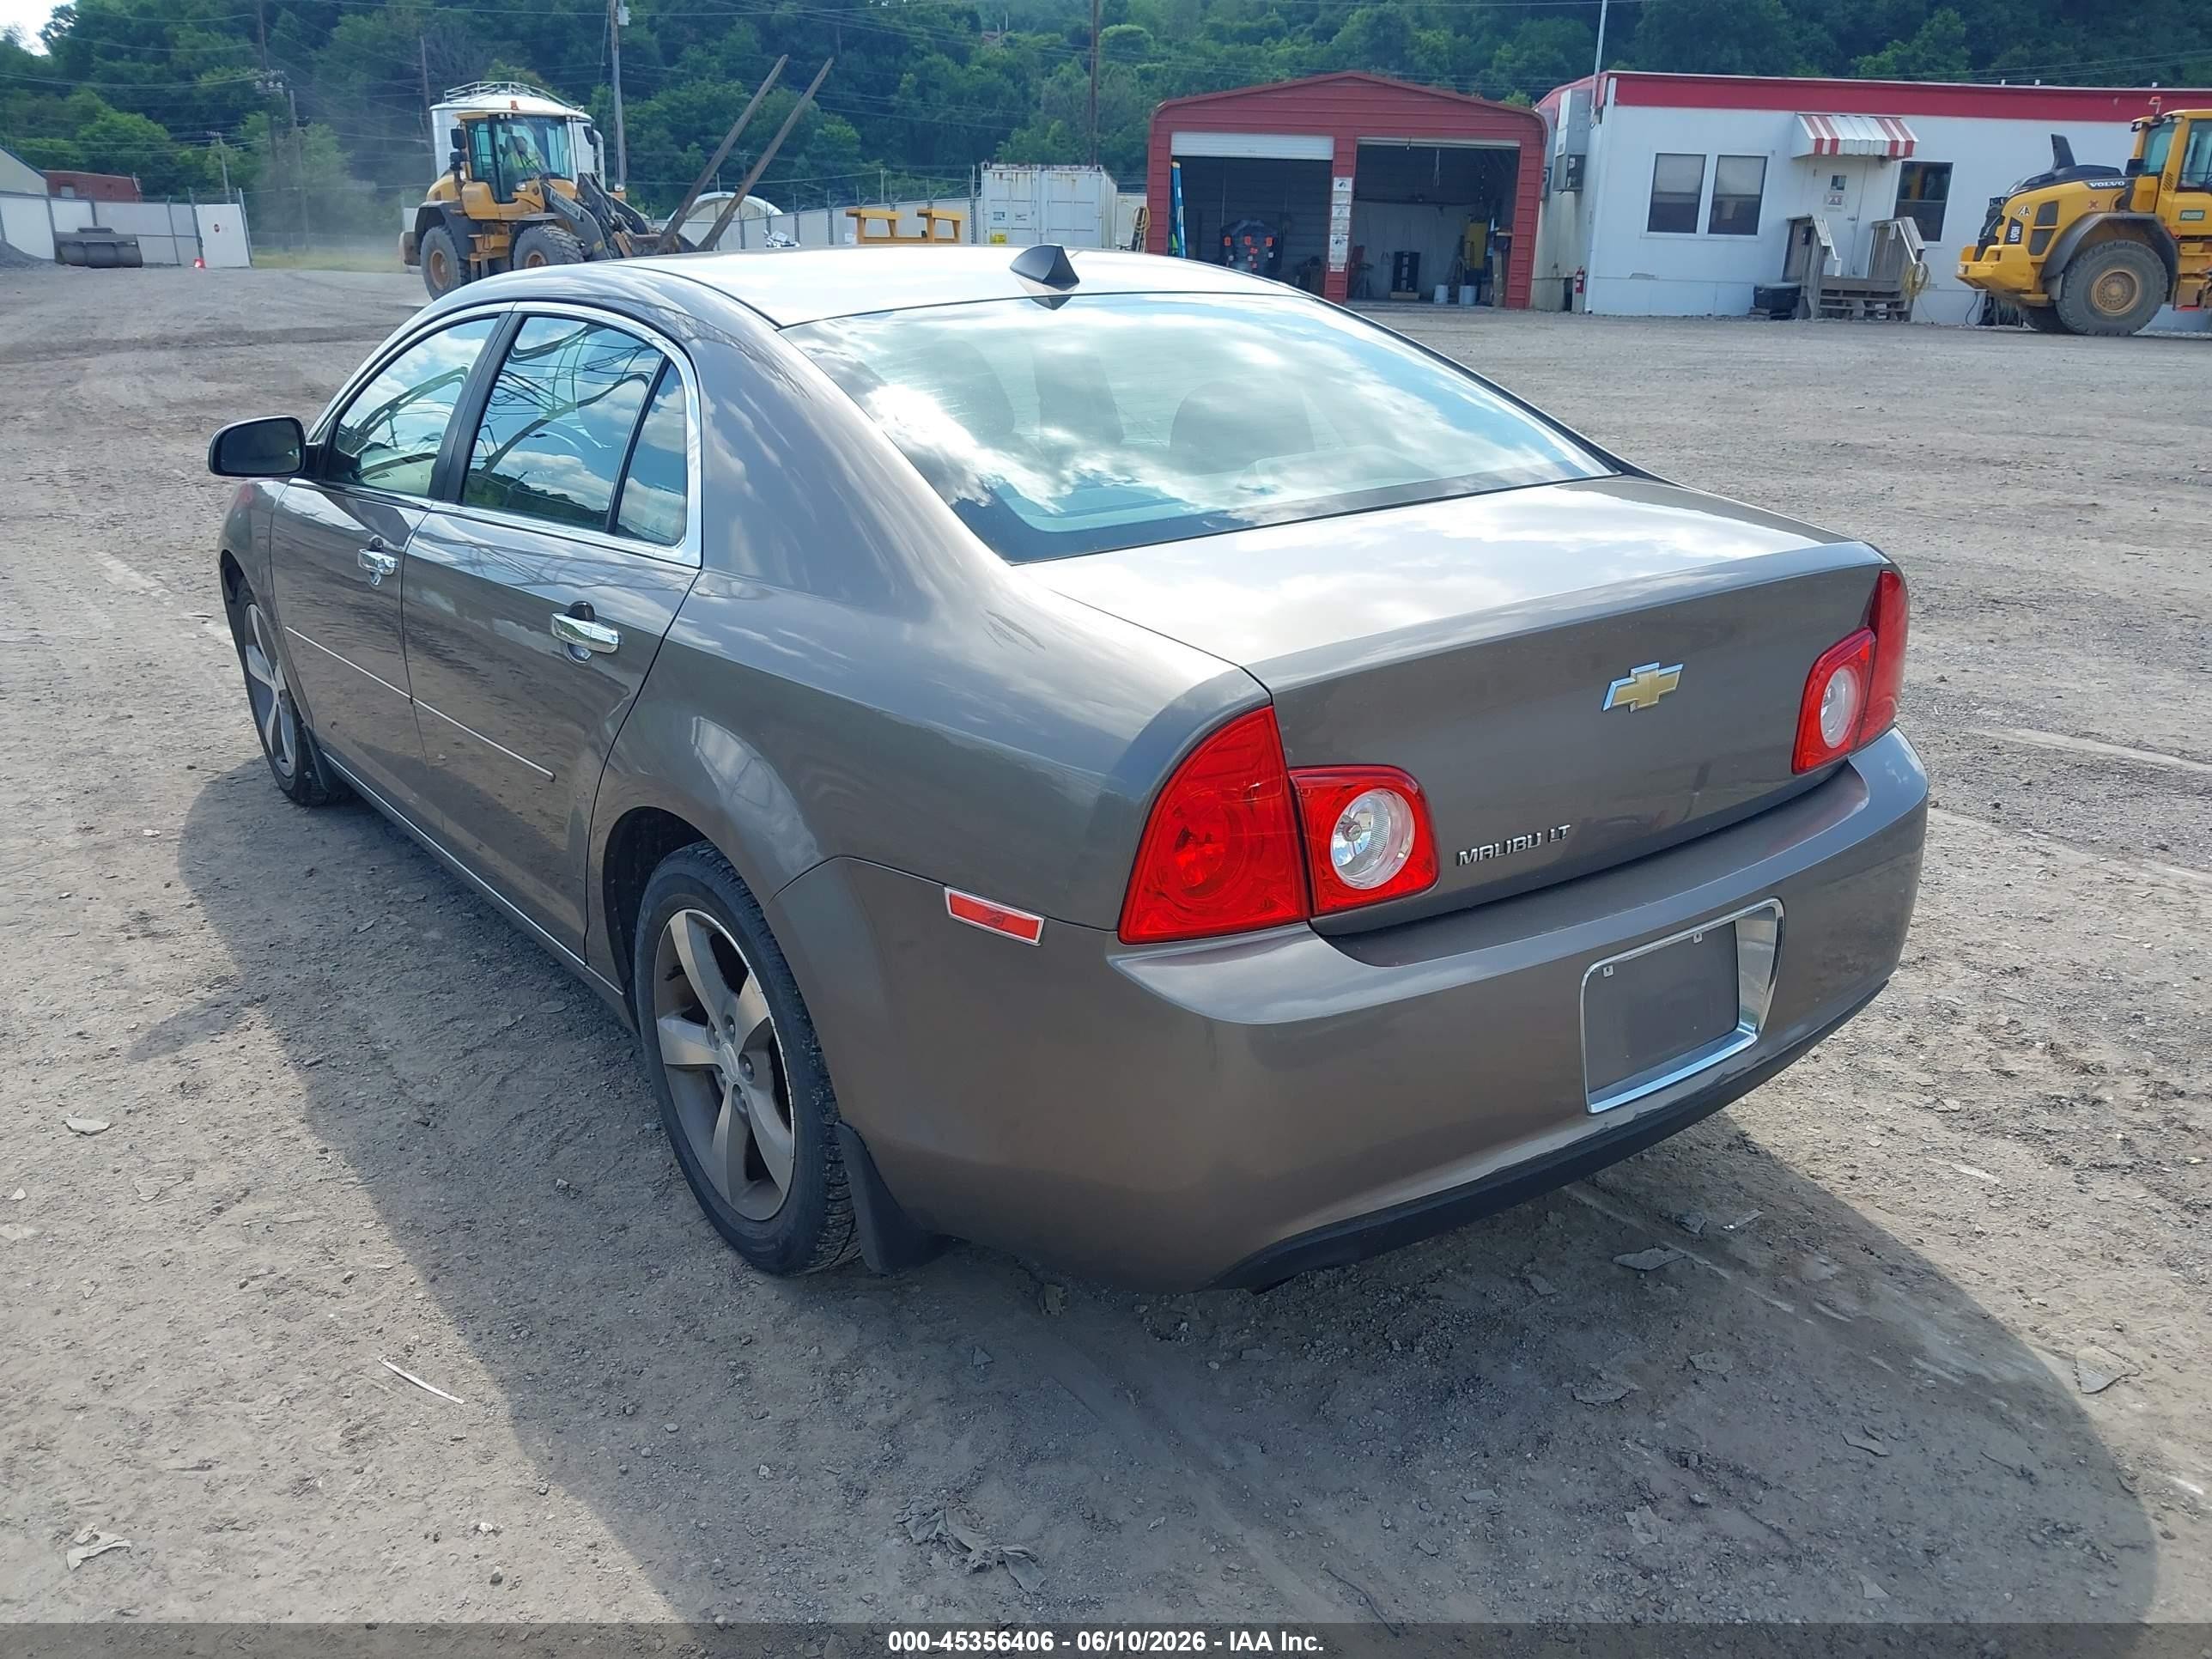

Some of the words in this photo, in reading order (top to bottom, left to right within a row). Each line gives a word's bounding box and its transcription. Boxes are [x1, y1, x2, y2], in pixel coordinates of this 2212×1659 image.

[2009, 226, 2021, 242] L90H
[1457, 832, 1542, 866] MALIBU
[1548, 824, 1571, 843] LT
